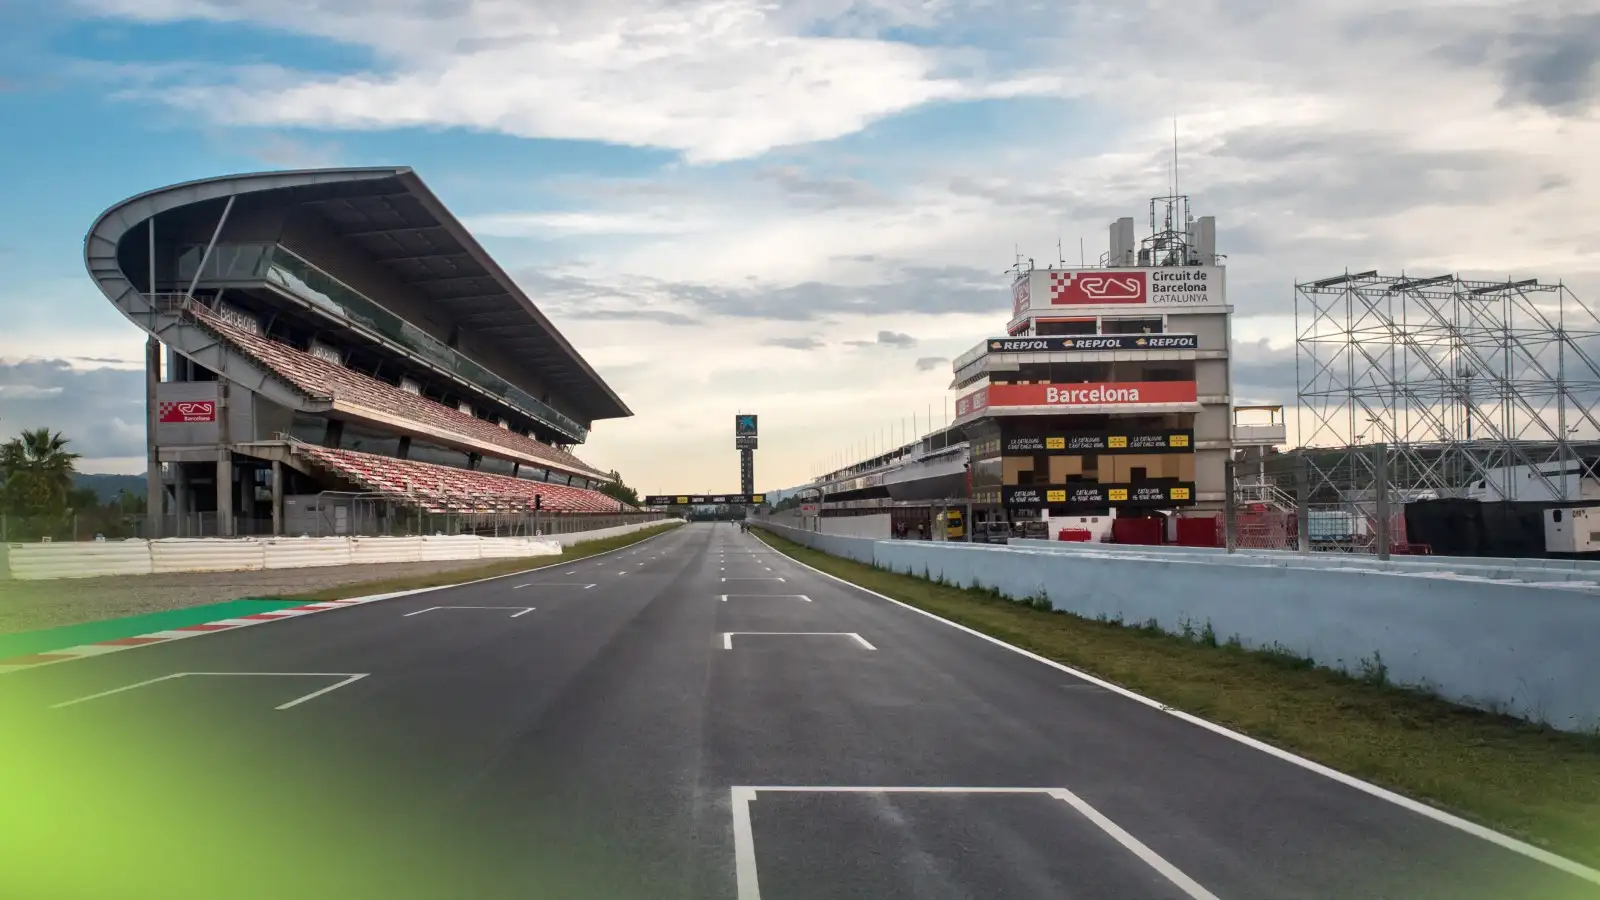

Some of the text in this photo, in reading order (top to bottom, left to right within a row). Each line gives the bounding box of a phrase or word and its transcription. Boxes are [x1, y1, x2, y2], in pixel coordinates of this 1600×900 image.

[1152, 270, 1207, 281] Circuit de
[1152, 282, 1207, 292] Barcelona
[1152, 294, 1209, 303] CATALUNYA
[1003, 341, 1048, 350] REPSOL
[1076, 339, 1122, 348] REPSOL
[1149, 338, 1194, 346] REPSOL
[1046, 384, 1139, 403] Barcelona
